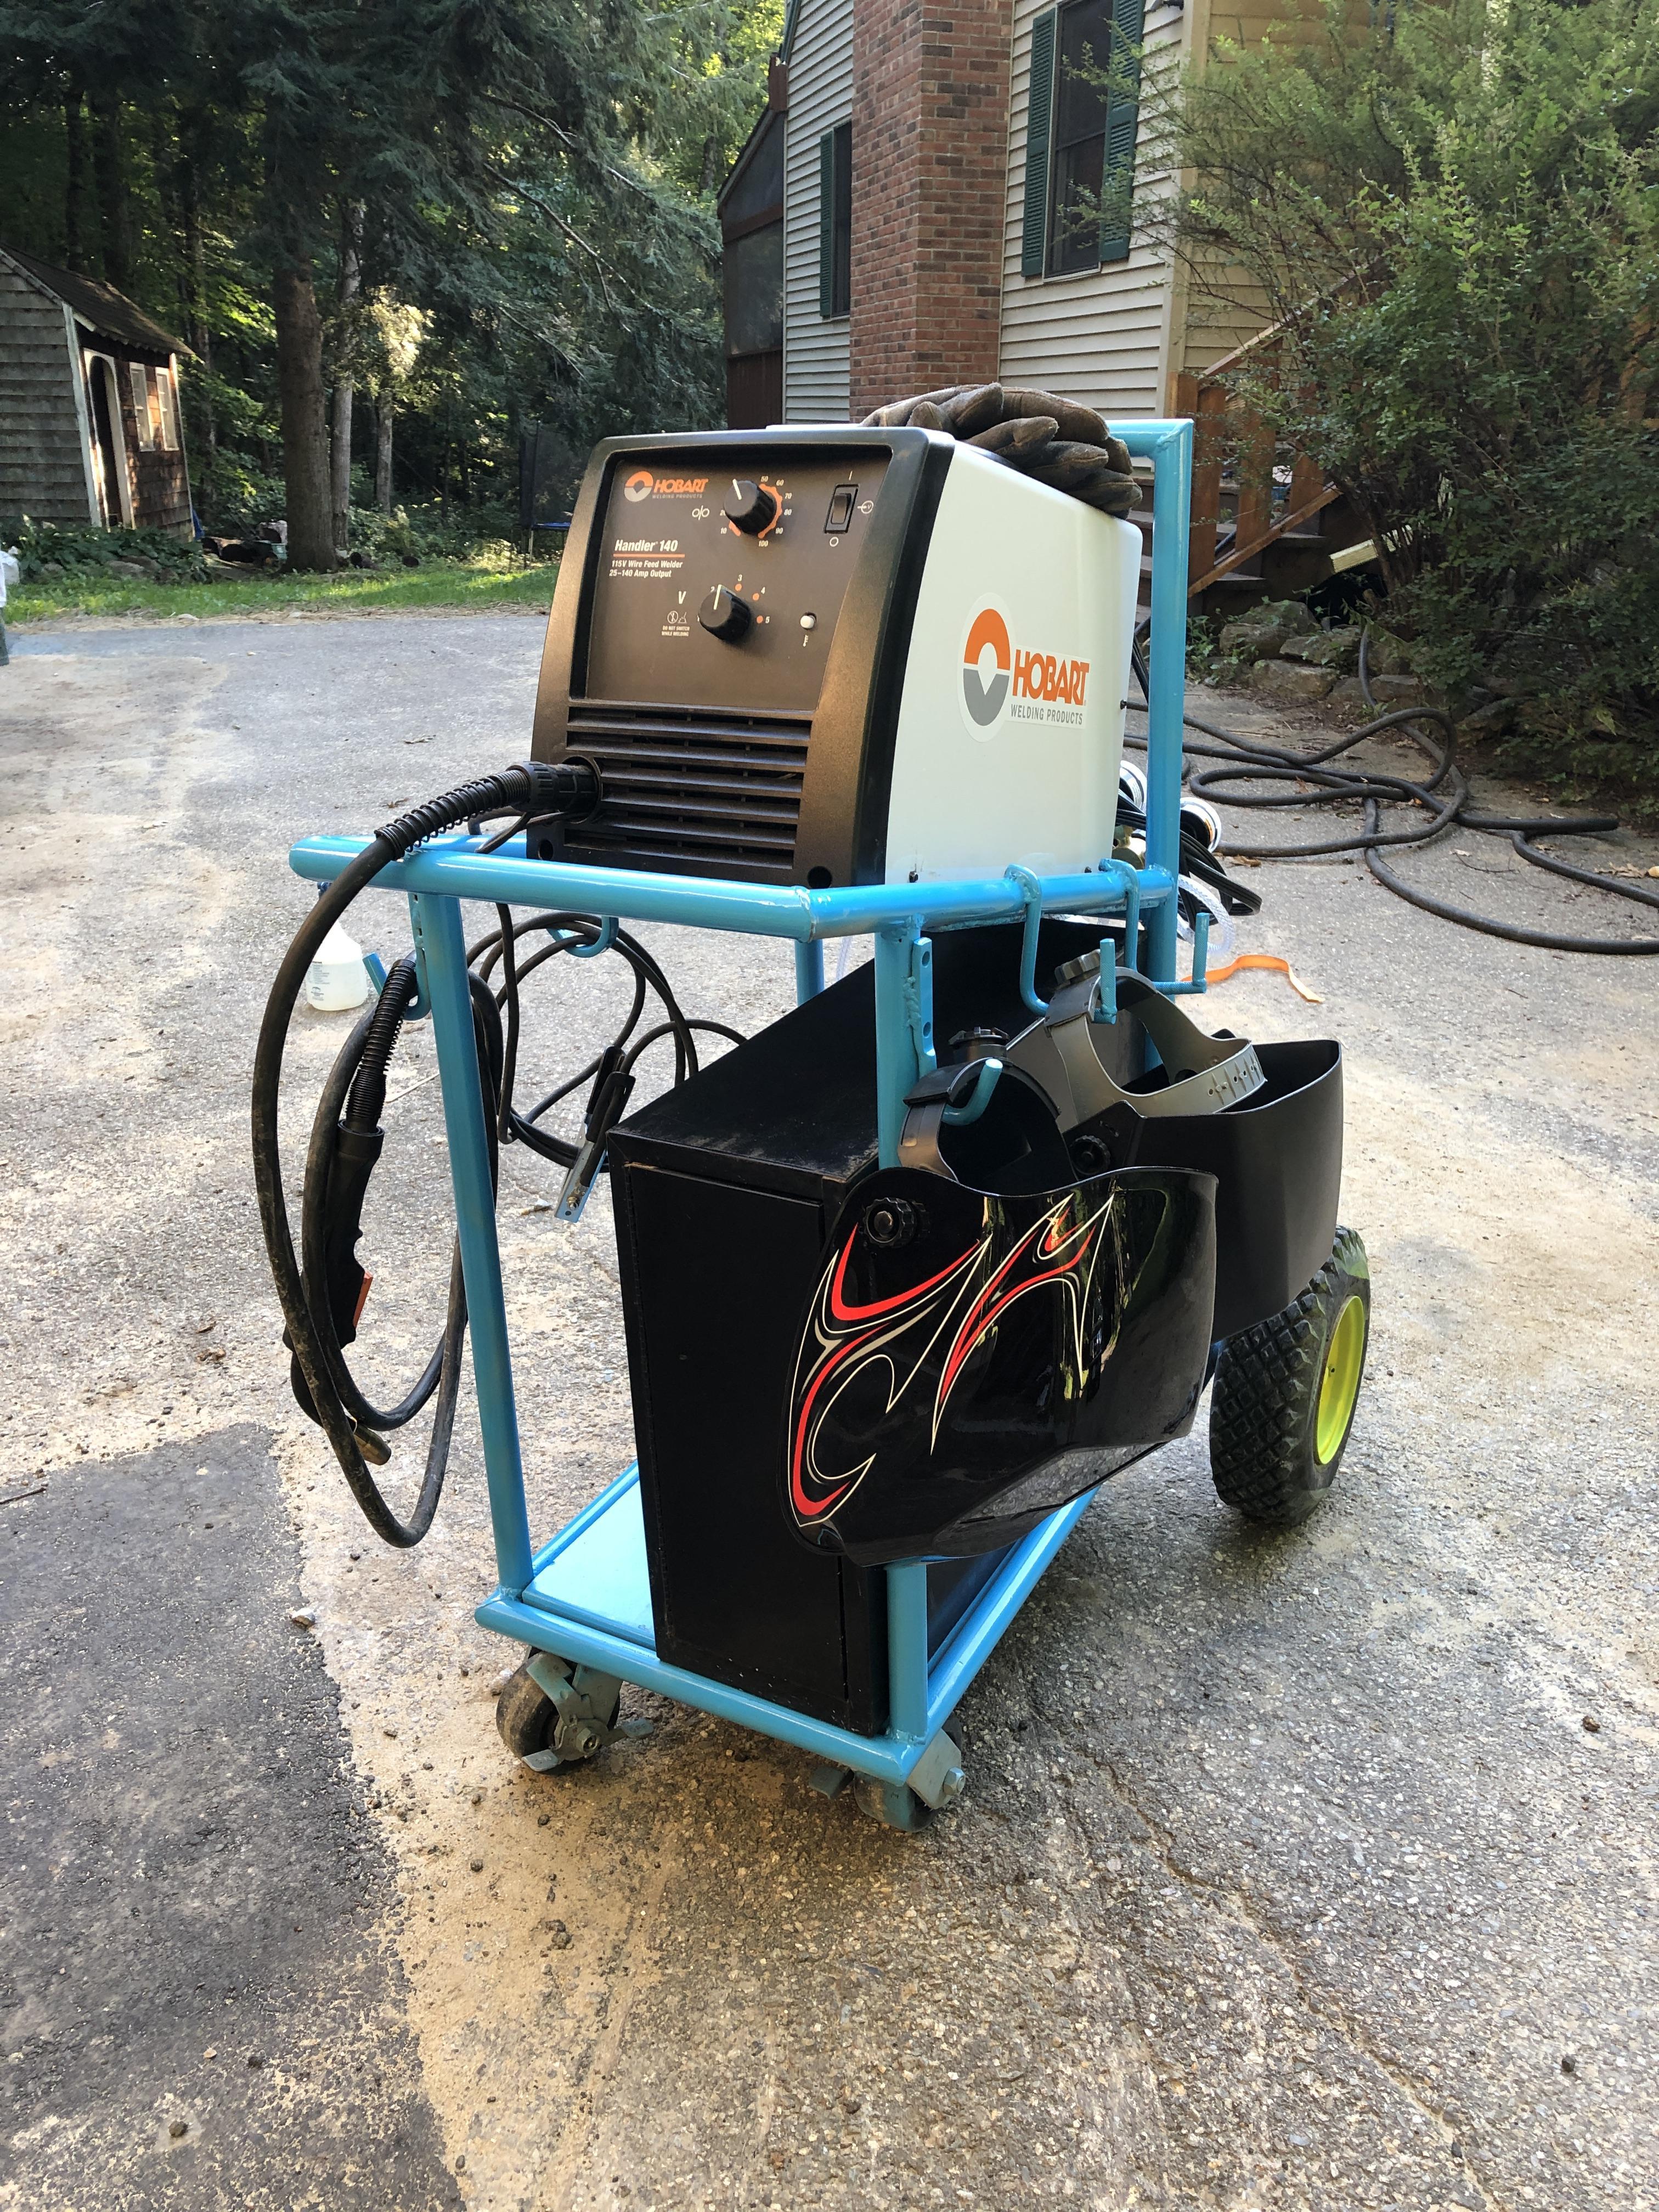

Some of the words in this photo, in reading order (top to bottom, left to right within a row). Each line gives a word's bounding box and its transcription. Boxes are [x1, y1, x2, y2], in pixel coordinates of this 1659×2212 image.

[653, 479, 709, 493] HOBART
[659, 540, 678, 551] 140
[661, 560, 683, 568] Welder
[634, 569, 649, 578] Amp
[650, 570, 672, 578] Output
[678, 591, 686, 605] V
[1012, 649, 1090, 706] HOBART
[1011, 704, 1044, 720] WELDING
[1047, 709, 1083, 725] PRODUCTS
